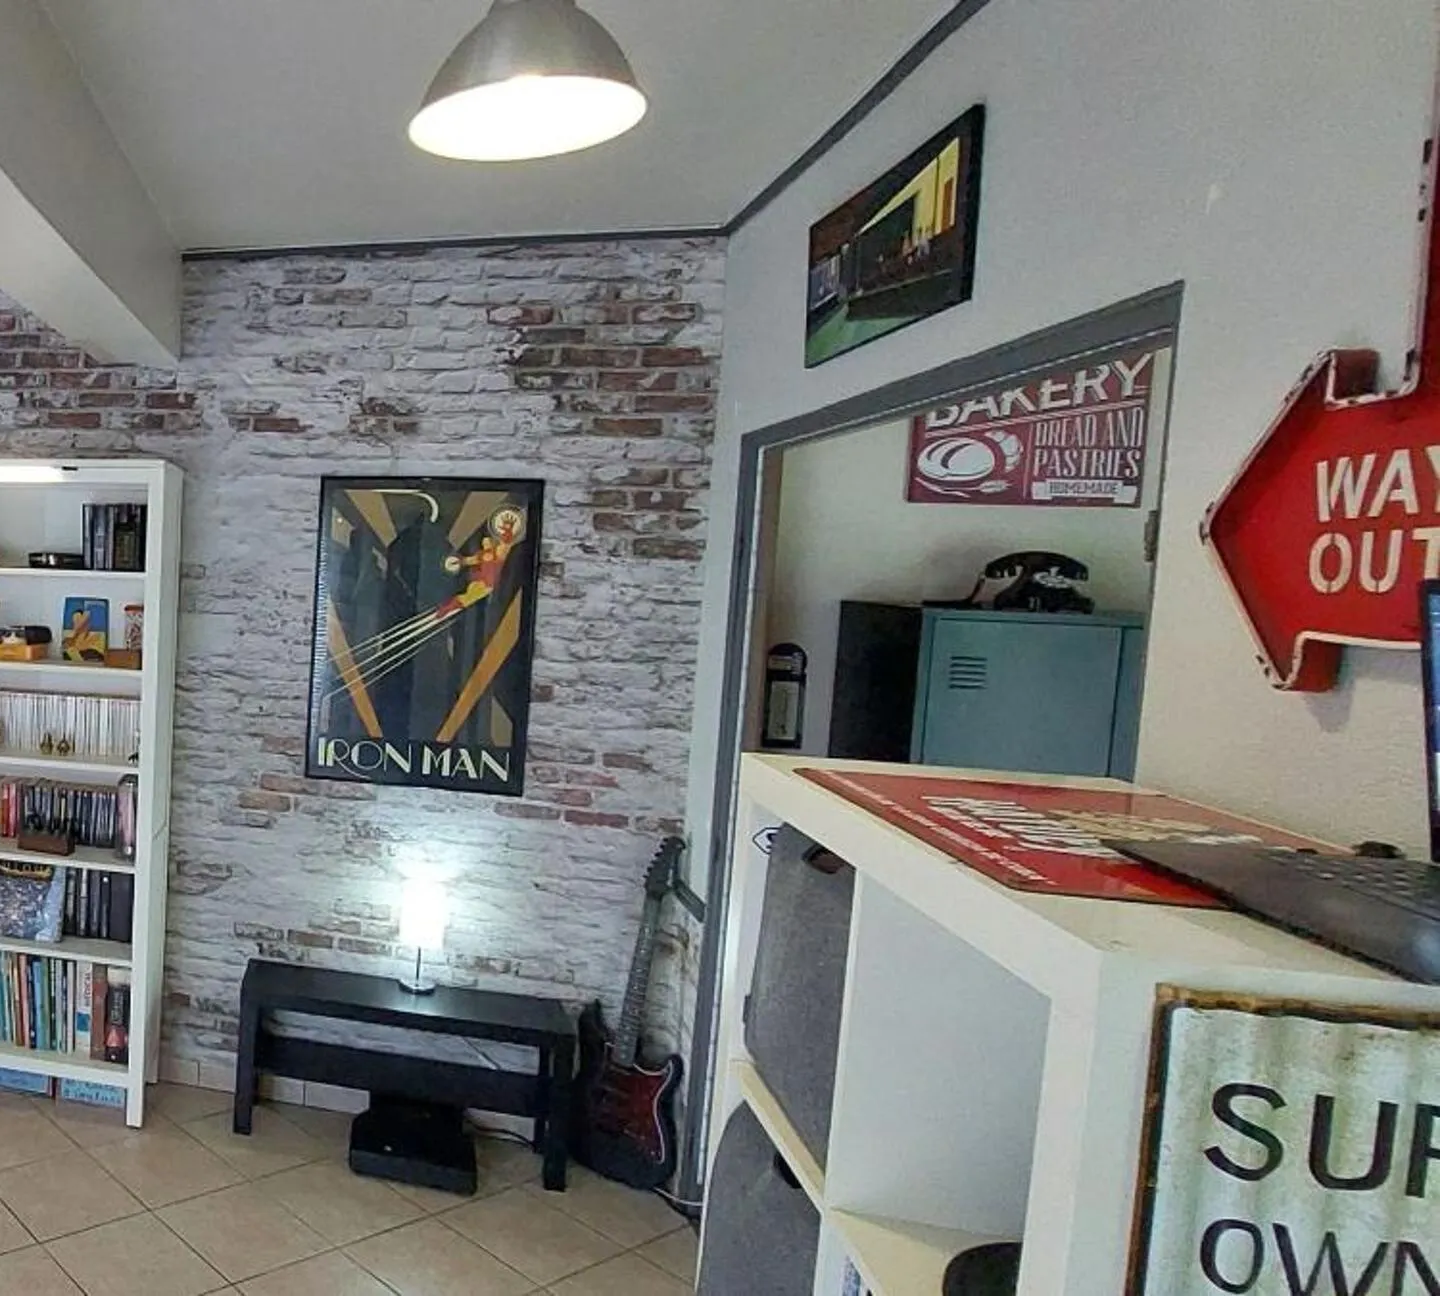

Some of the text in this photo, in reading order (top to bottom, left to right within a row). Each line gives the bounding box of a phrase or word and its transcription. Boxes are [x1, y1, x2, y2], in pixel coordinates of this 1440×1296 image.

[925, 353, 1154, 429] BAKERY
[1035, 407, 1145, 448] BREAD AND
[1033, 449, 1142, 477] PASTRIES
[1049, 482, 1119, 495] HOMEMADE
[318, 737, 510, 783] IRON MAN
